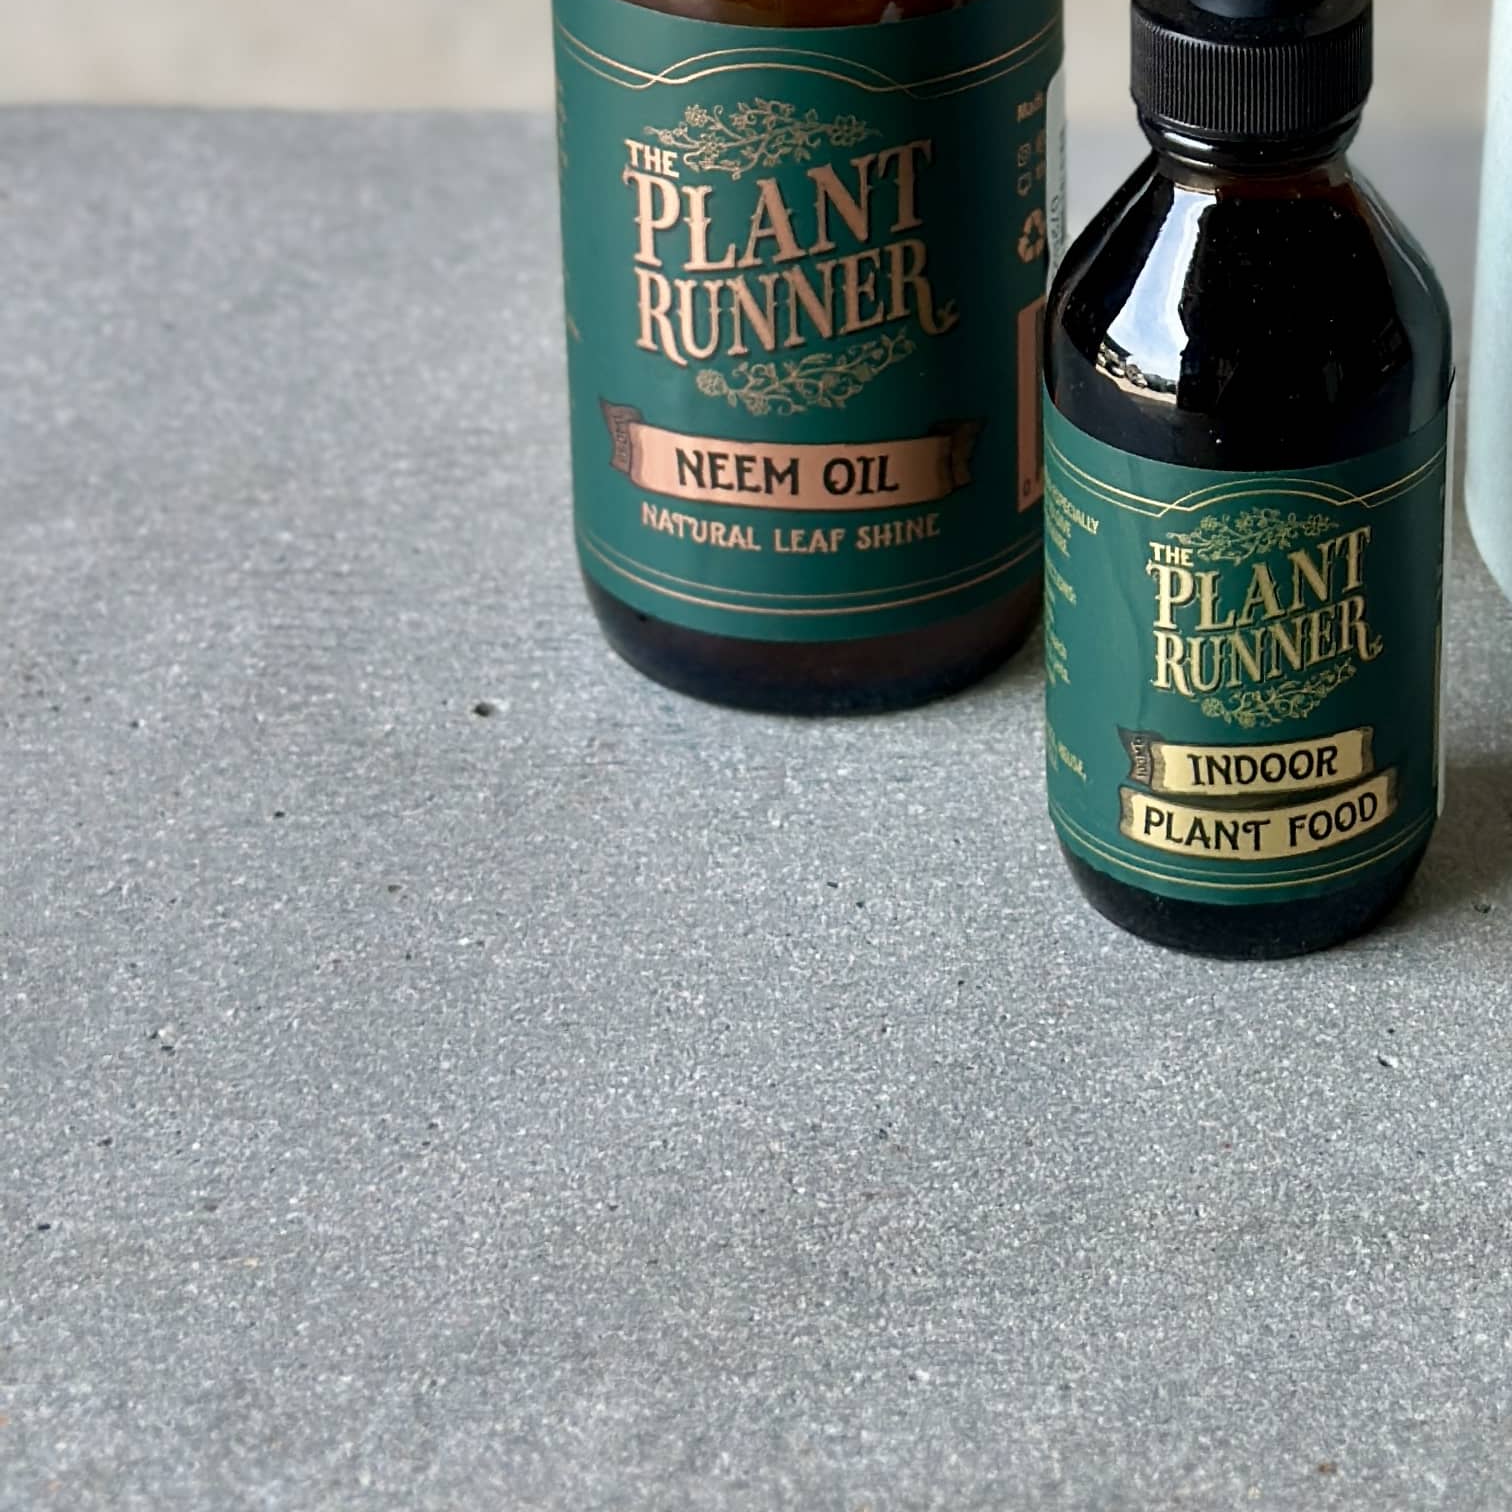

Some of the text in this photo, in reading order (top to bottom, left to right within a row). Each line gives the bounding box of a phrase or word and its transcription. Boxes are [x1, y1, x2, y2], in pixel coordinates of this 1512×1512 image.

[624, 139, 680, 178] THE
[622, 139, 933, 272] PLANT
[634, 239, 958, 366] RUNNER
[675, 447, 900, 495] NEEM OIL
[641, 502, 941, 553] NATURAL LEAF SHINE
[1149, 541, 1193, 567] THE
[1147, 526, 1372, 631] PLANT
[1152, 594, 1384, 697] RUNNER
[1191, 745, 1339, 786] INDOOR
[1143, 792, 1379, 851] PLANT FOOD
